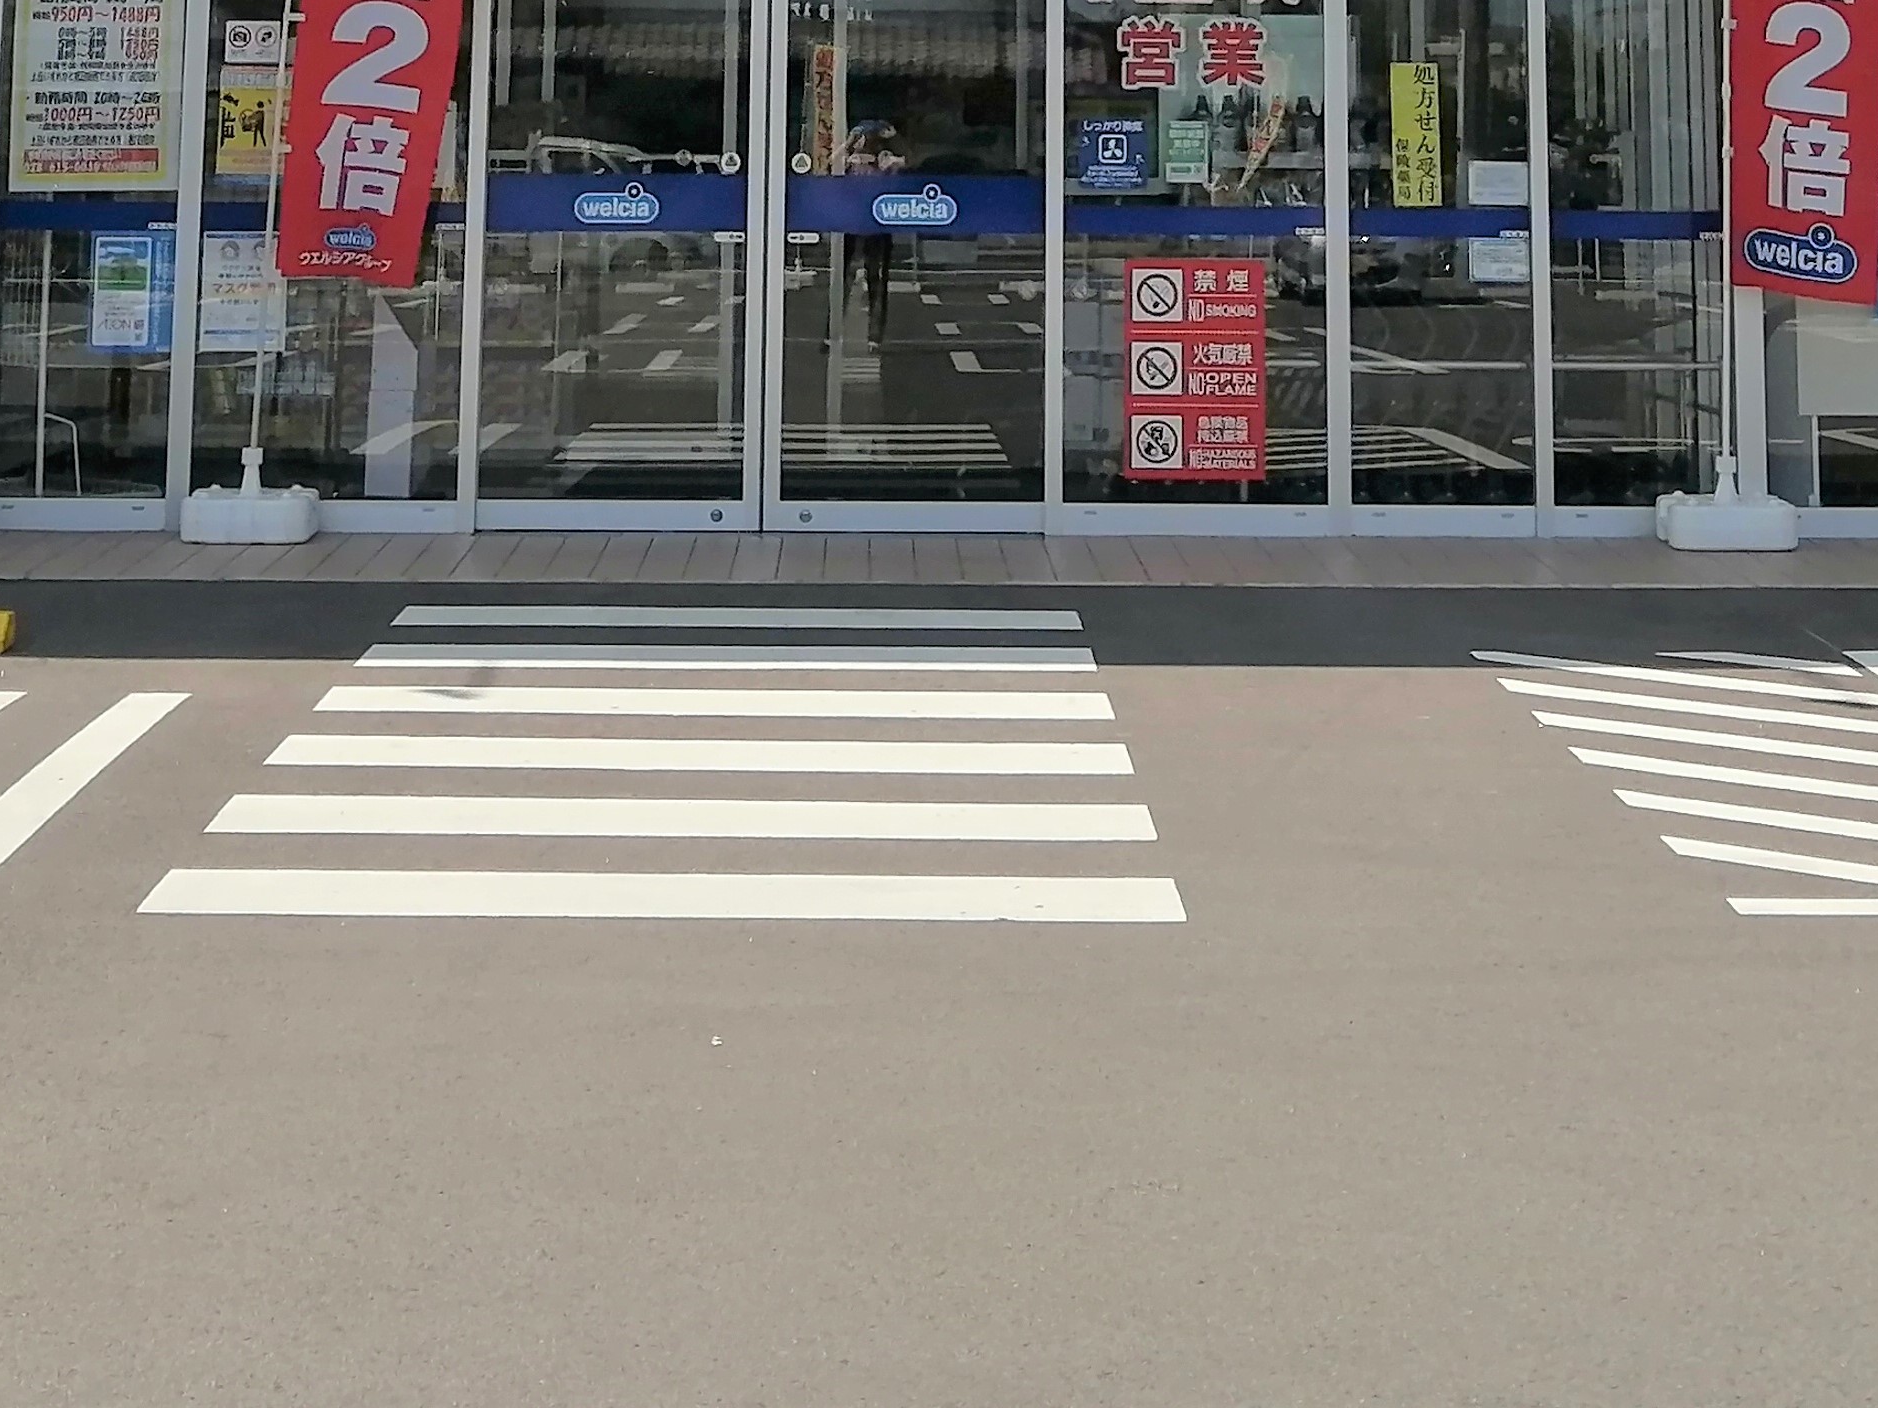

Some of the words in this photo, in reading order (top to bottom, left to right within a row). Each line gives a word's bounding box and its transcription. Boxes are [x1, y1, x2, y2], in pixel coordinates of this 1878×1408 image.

[1118, 15, 1267, 90] 営業
[1413, 64, 1437, 202] 処方せん受付
[1754, 238, 1845, 275] welcia
[1193, 269, 1249, 292] 禁煙
[1205, 303, 1257, 318] SMOKING
[1206, 372, 1257, 384] OPEN
[1206, 384, 1257, 396] FLAME
